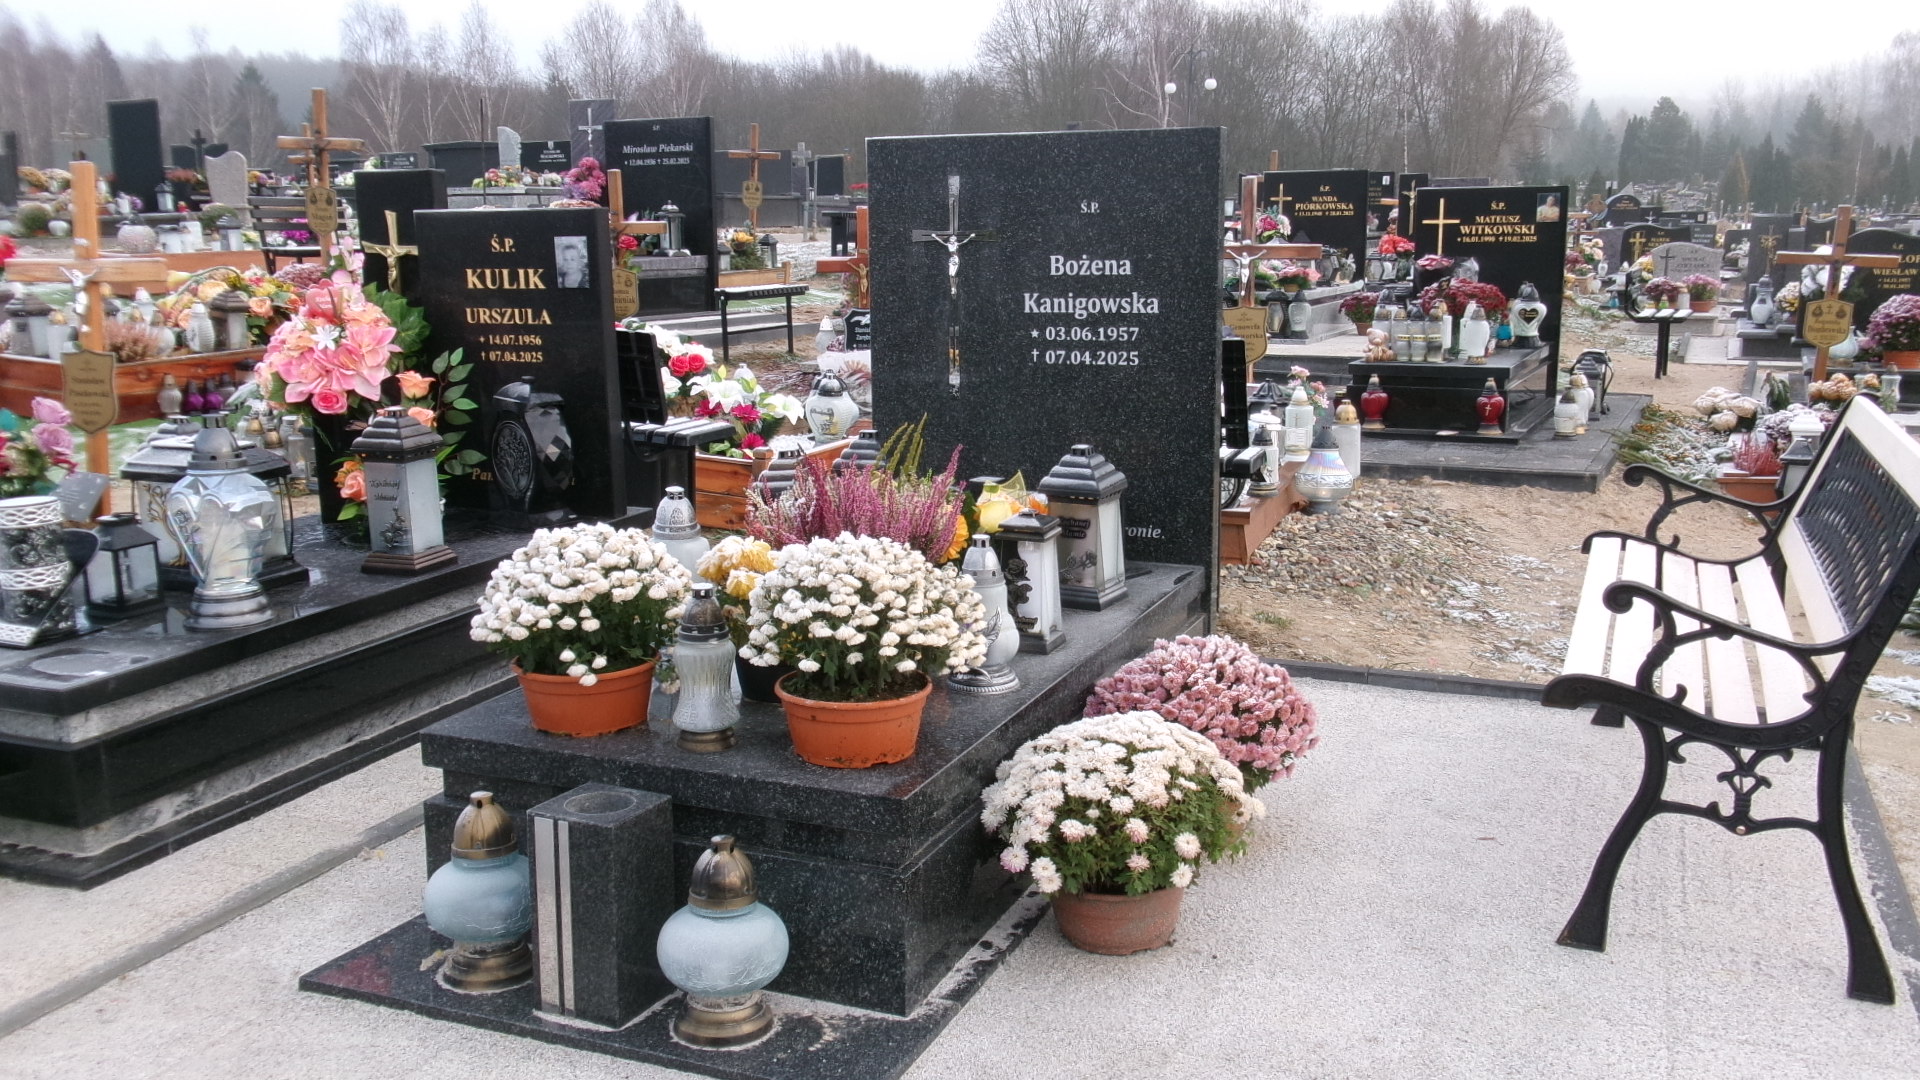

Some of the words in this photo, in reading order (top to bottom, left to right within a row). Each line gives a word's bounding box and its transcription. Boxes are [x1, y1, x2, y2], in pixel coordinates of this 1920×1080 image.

[622, 144, 657, 154] Mirosław
[659, 142, 694, 152] Piekarski
[1080, 200, 1100, 214] Ś.P.
[1295, 201, 1354, 211] PIÓRKOWSKA
[1490, 200, 1507, 210] Ś.P.
[1474, 215, 1521, 223] MATEUSZ
[1459, 224, 1536, 235] WITKOWSKI
[490, 233, 516, 252] Ś.P.
[1050, 254, 1132, 275] Bożena
[465, 268, 547, 289] KULIK
[1023, 292, 1160, 319] Kanigowska
[465, 307, 552, 325] URSZULA
[488, 334, 542, 345] 14.07.1956
[1045, 326, 1140, 341] 03.06.1957
[489, 351, 544, 362] 07.04.2025
[1045, 350, 1140, 366] 07.04.2025
[1124, 525, 1165, 539] onie.
